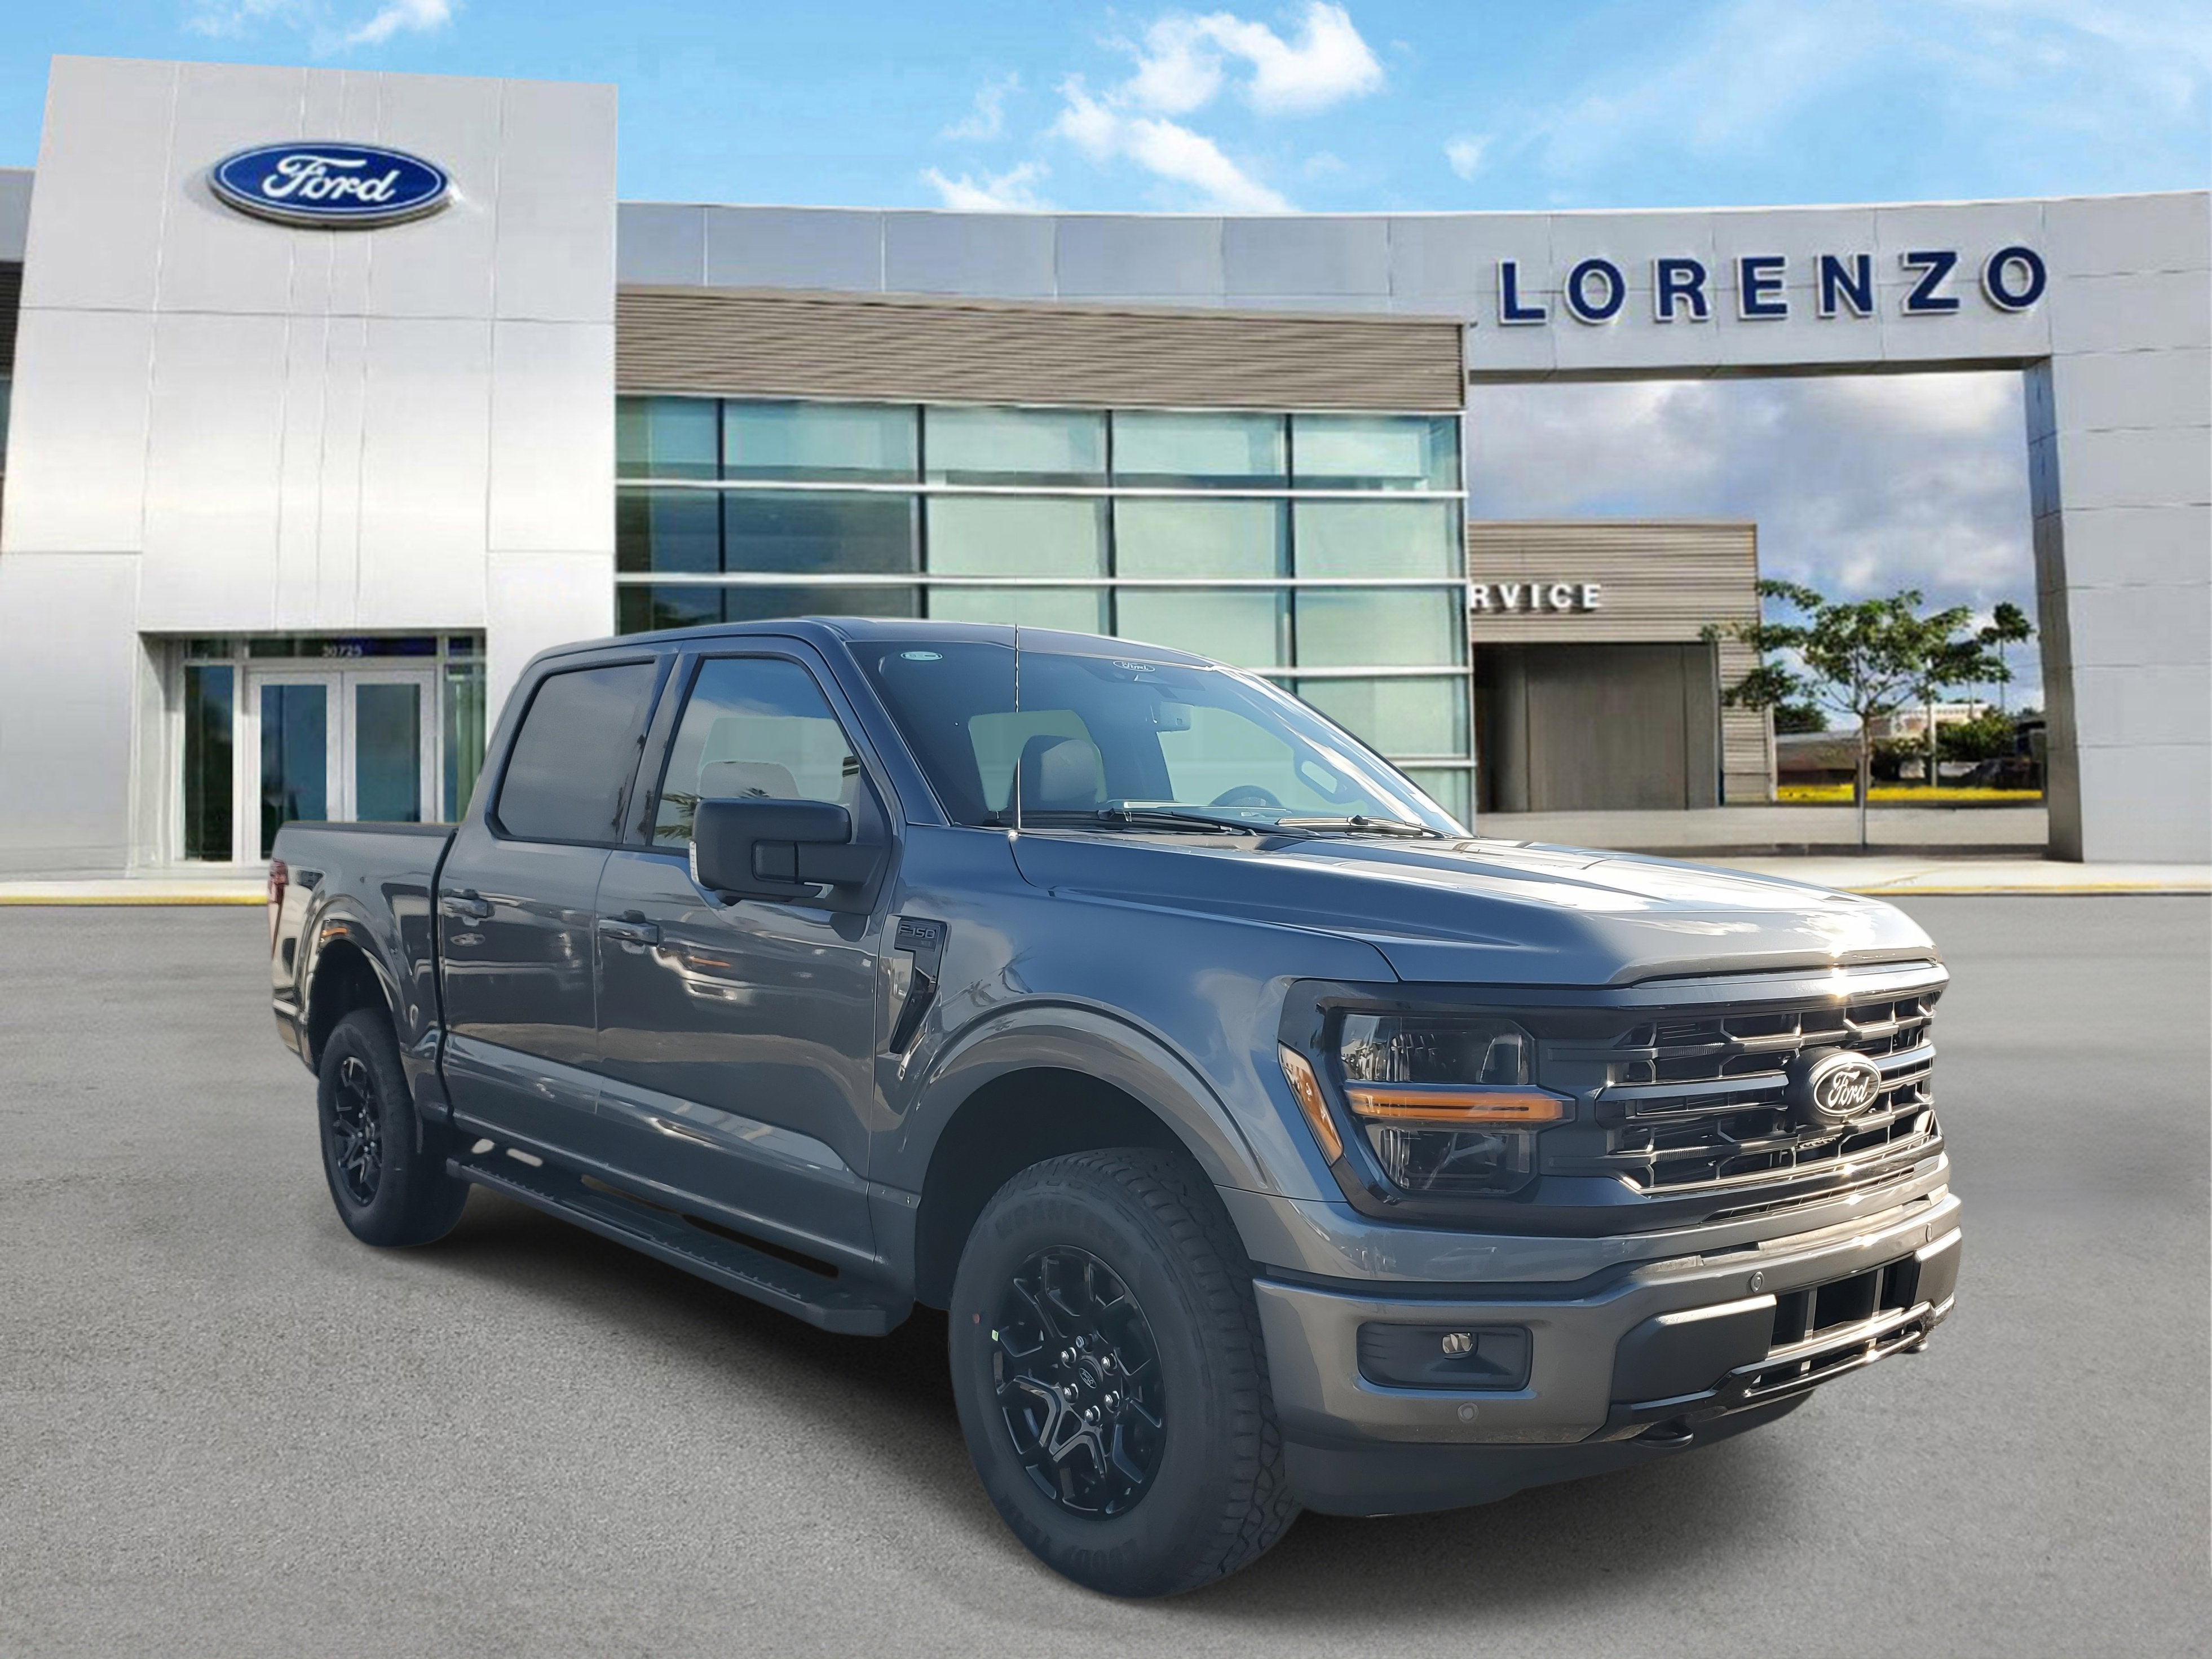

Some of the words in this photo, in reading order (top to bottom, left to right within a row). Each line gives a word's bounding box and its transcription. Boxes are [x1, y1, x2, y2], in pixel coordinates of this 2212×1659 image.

[262, 154, 401, 202] Ford
[1499, 246, 2047, 325] LORENZO
[1122, 662, 1149, 670] Ford
[1828, 1070, 1870, 1108] Ford
